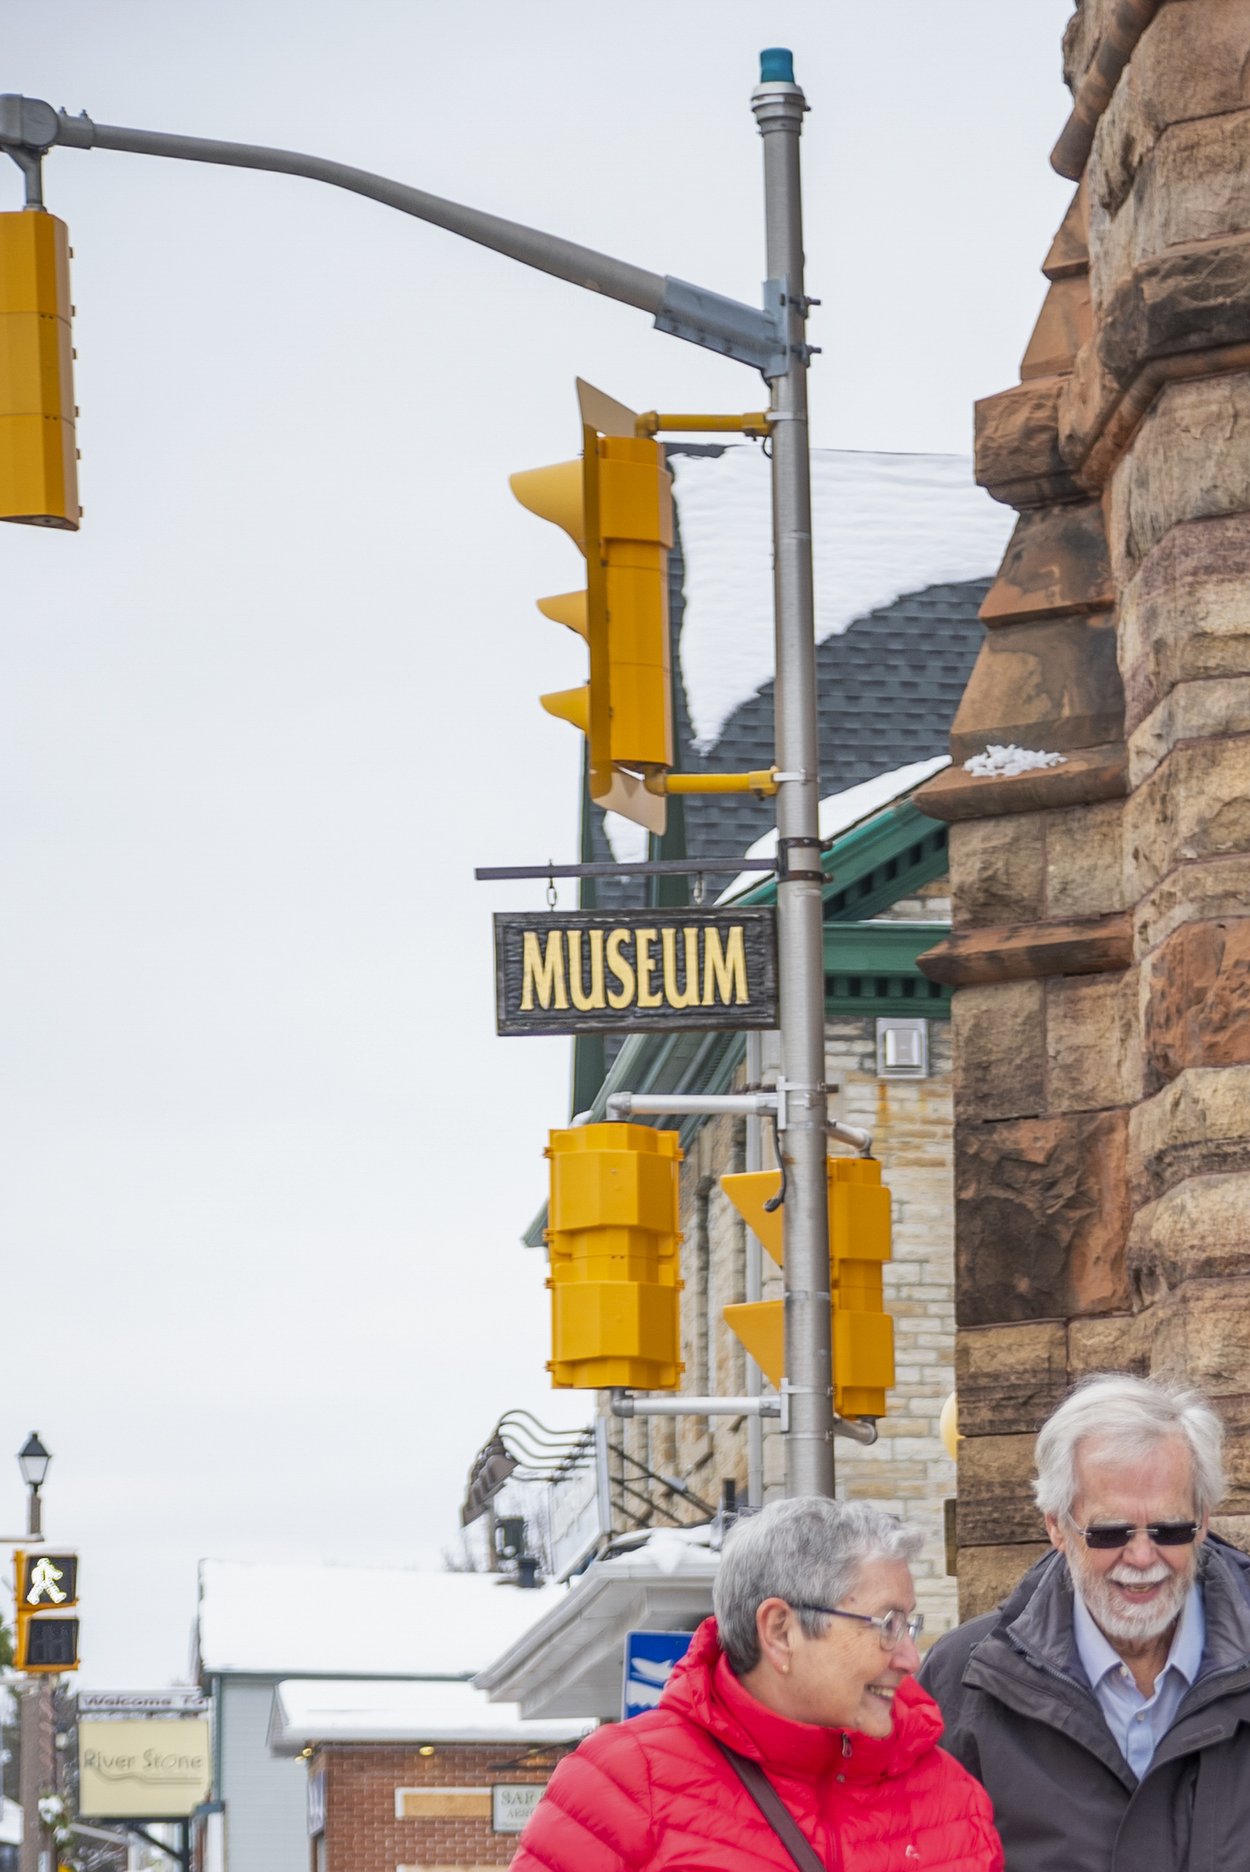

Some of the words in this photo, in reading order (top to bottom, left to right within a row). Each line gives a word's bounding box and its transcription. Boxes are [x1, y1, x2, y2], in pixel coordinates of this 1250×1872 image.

[519, 926, 750, 1011] MUSEUM
[86, 1694, 172, 1706] Welcome
[84, 1748, 136, 1769] River
[143, 1747, 204, 1769] Stone
